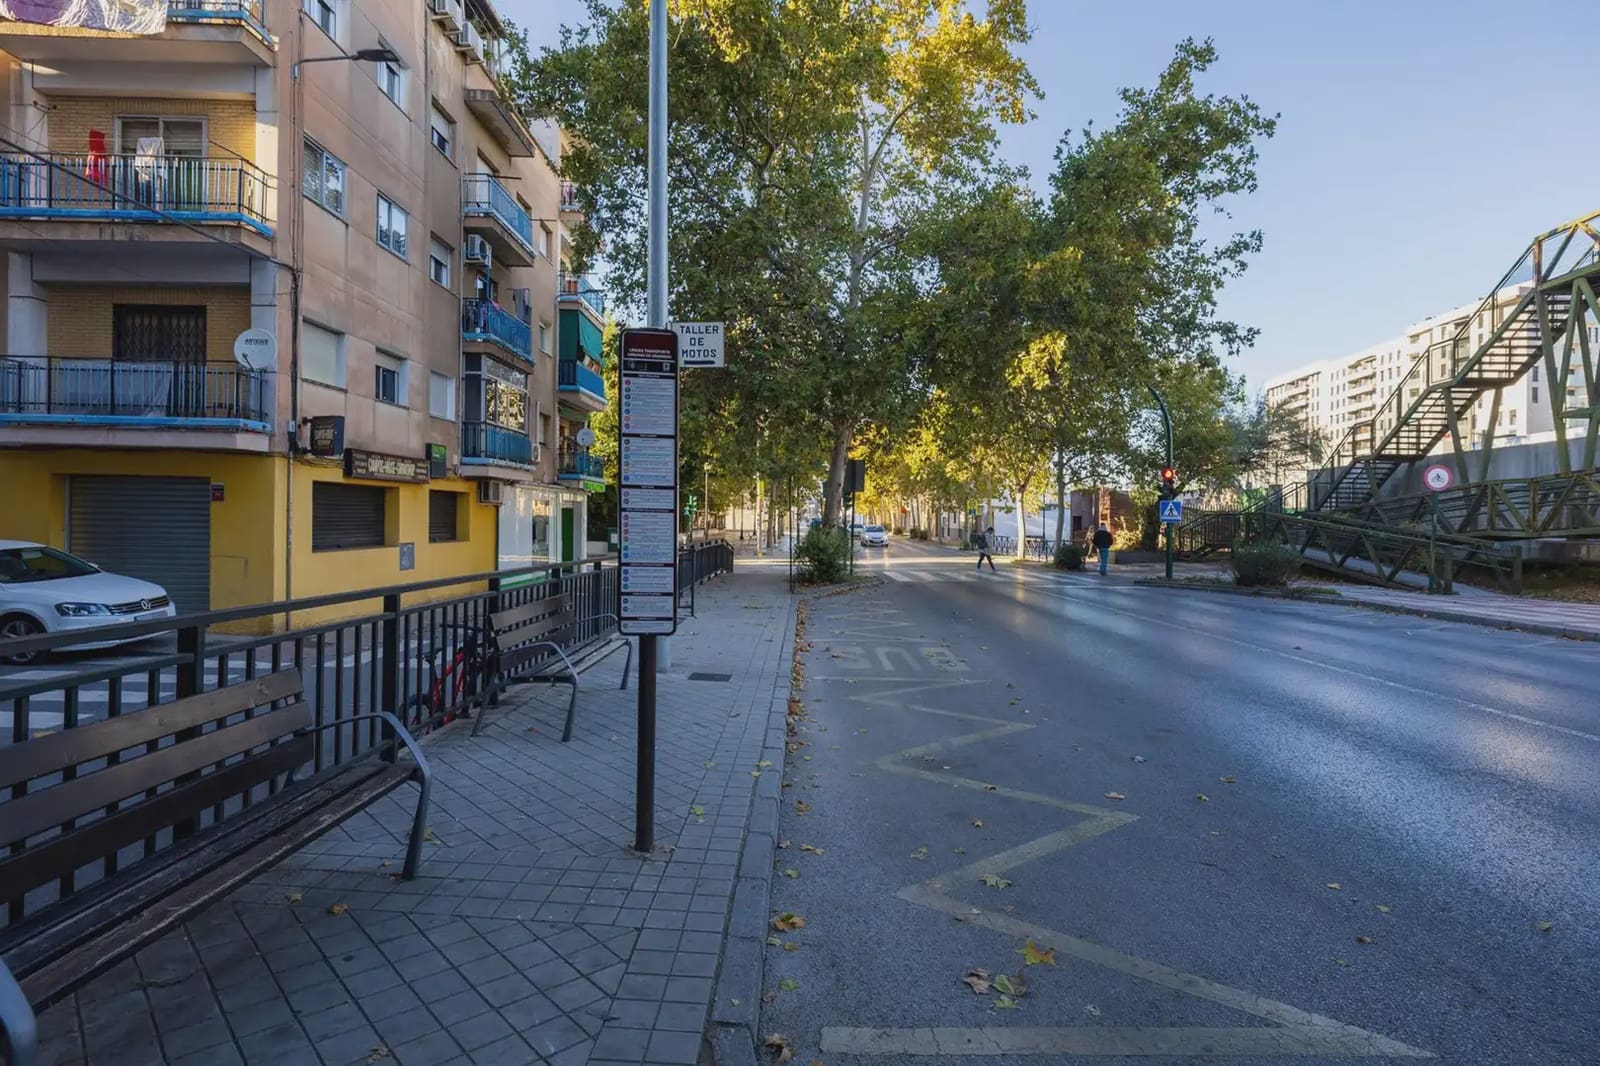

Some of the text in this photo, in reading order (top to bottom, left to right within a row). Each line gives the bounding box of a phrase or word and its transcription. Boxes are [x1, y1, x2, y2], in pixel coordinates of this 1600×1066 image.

[680, 325, 719, 334] TALLER
[689, 337, 704, 346] DE
[681, 349, 717, 358] MOTOS
[832, 646, 972, 673] BUS
